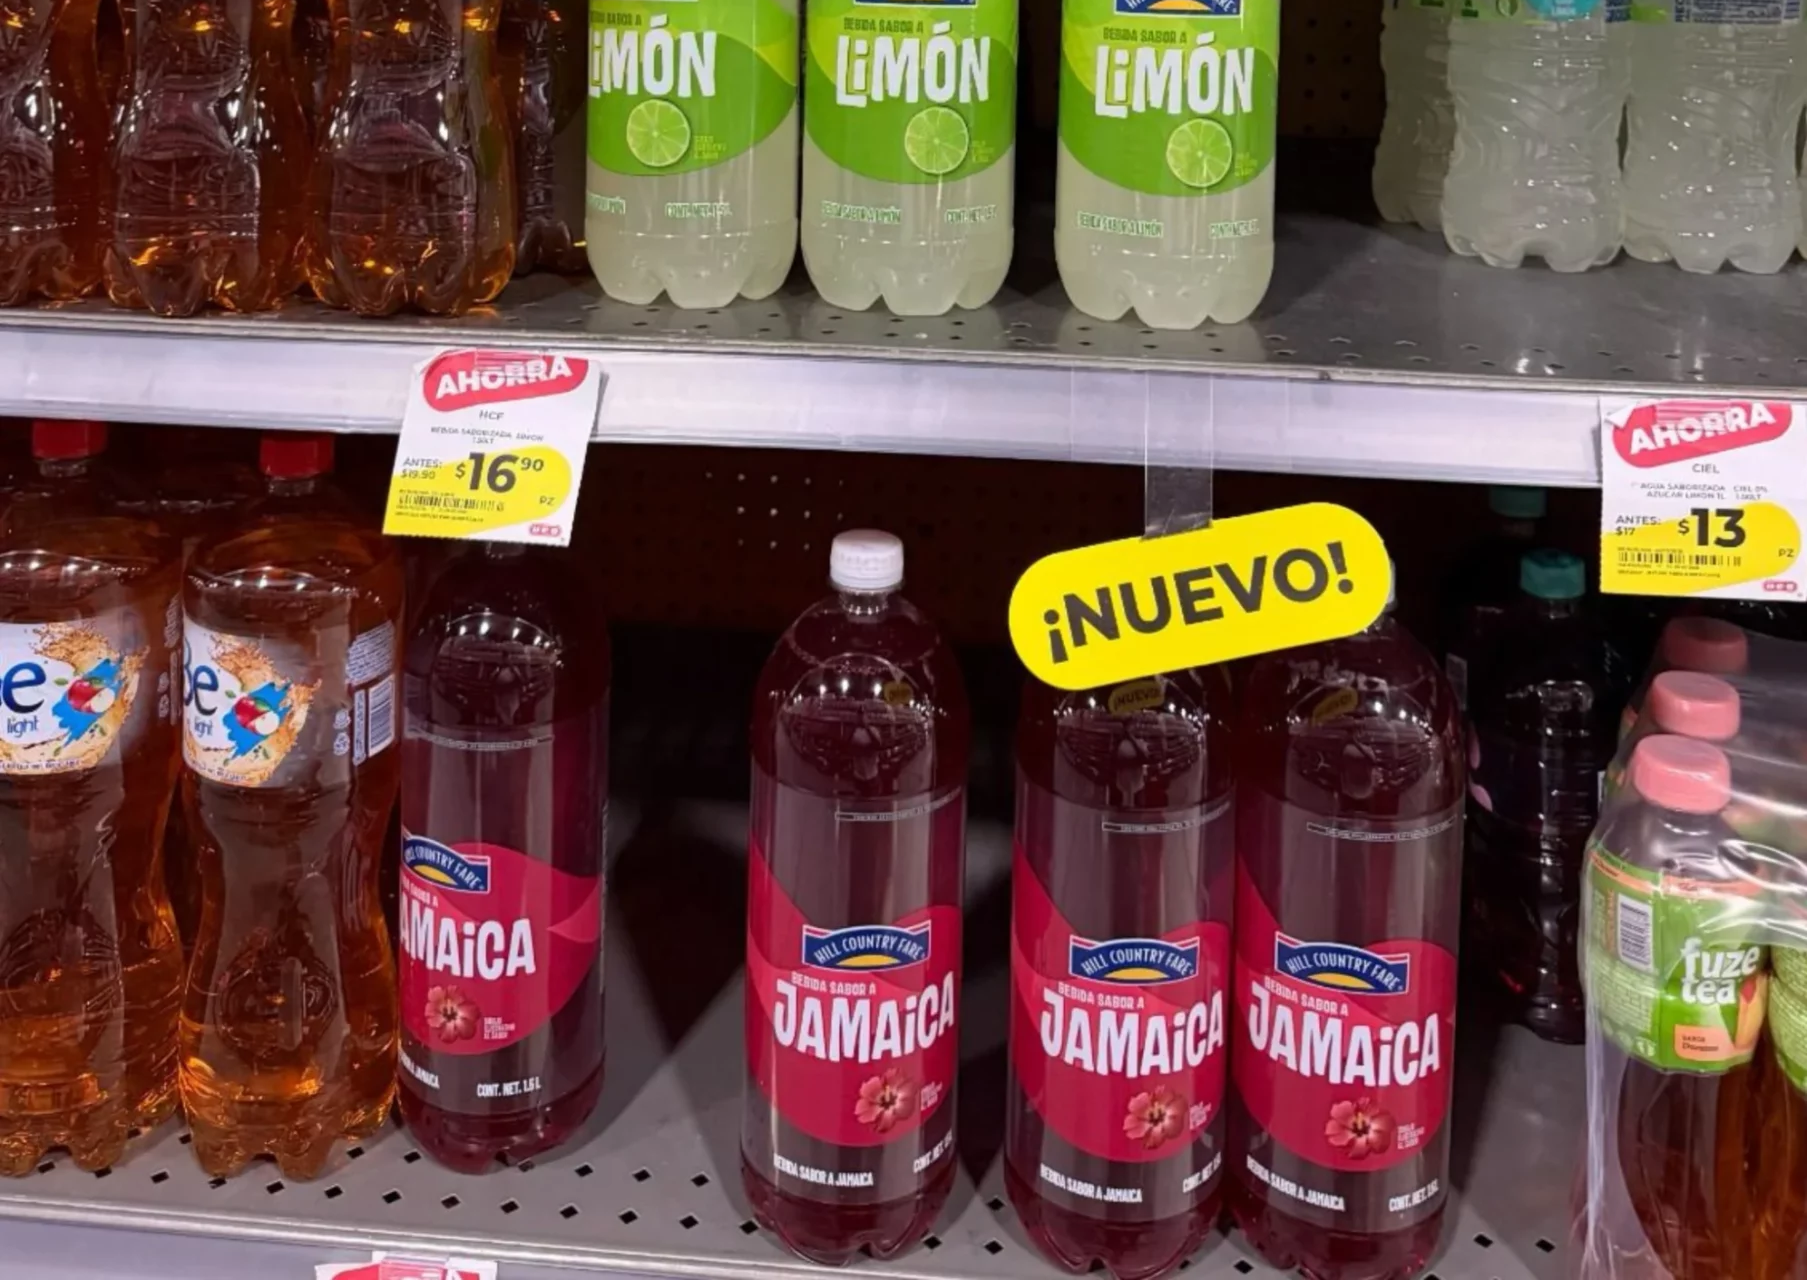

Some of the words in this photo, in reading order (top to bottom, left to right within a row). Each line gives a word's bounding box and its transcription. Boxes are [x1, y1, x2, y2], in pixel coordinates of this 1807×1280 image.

[1140, 29, 1176, 44] SABOR
[435, 355, 572, 399] AHORRA
[479, 410, 504, 420] HCF
[1630, 403, 1776, 455] AHORRA
[401, 469, 436, 479] $19.90
[403, 457, 442, 469] ANTES:
[1692, 463, 1720, 474] CIEL
[539, 496, 555, 506] PZ
[1733, 485, 1752, 493] CIEL
[1615, 527, 1635, 536] $17
[1616, 515, 1662, 525] ANTES:
[1678, 507, 1746, 548] $13
[1778, 548, 1795, 558] PZ
[1043, 540, 1354, 665] ¡NUEVO!
[0, 662, 46, 714] e
[7, 715, 39, 738] light
[454, 862, 482, 889] FARE
[400, 892, 536, 980] AMAiCA
[813, 942, 841, 964] HILL
[842, 934, 898, 953] COUNTRY
[898, 938, 923, 960] FARE
[1081, 954, 1109, 975] HILL
[1110, 948, 1165, 965] COUNTRY
[1165, 954, 1190, 976] FARE
[1286, 953, 1313, 974] HILL
[1313, 952, 1371, 974] COUNTRY
[1371, 964, 1401, 990] FARE
[1680, 936, 1760, 979] fuze
[791, 971, 827, 992] BEBIDA
[829, 979, 866, 995] SABOR
[869, 981, 876, 995] A
[1058, 982, 1094, 1005] BEBIDA
[1097, 992, 1134, 1010] SABOR
[1136, 996, 1145, 1010] A
[1264, 976, 1298, 1004] BEBIDA
[1301, 990, 1339, 1015] SABOR
[1340, 1002, 1348, 1017] A
[1680, 974, 1737, 1005] tea
[477, 1083, 502, 1098] CONT.
[503, 1081, 522, 1096] NET.
[799, 1165, 827, 1184] SABOR
[835, 1172, 874, 1187] JAMAICA
[1066, 1176, 1095, 1199] SABOR
[1103, 1188, 1143, 1203] JAMAICA
[1270, 1173, 1298, 1199] SABOR
[1304, 1189, 1345, 1212] JAMAICA
